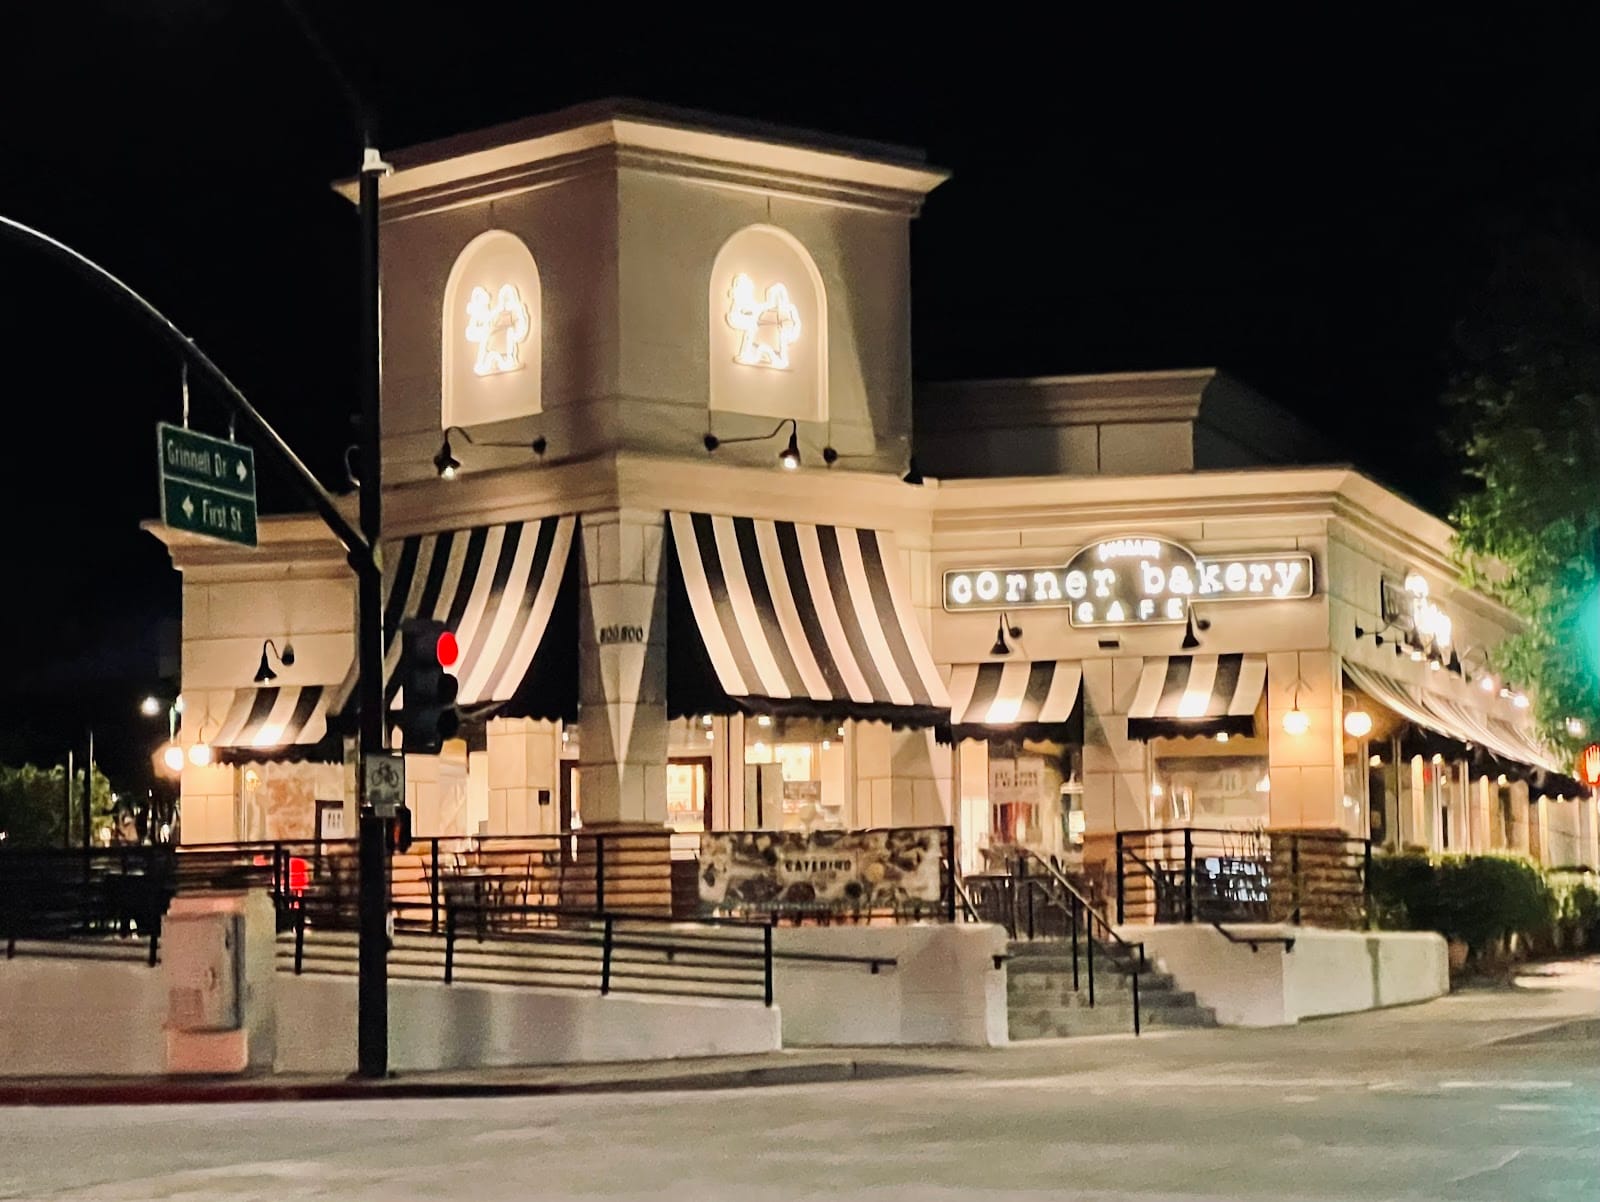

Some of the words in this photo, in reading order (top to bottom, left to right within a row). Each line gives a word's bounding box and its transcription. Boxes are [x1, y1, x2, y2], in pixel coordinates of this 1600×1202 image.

[167, 440, 211, 475] Grinnell
[214, 453, 227, 478] Dr
[202, 499, 227, 529] First
[229, 506, 243, 533] St
[951, 567, 1117, 604] corner
[1141, 560, 1302, 599] bakery
[1077, 598, 1185, 623] CAFE
